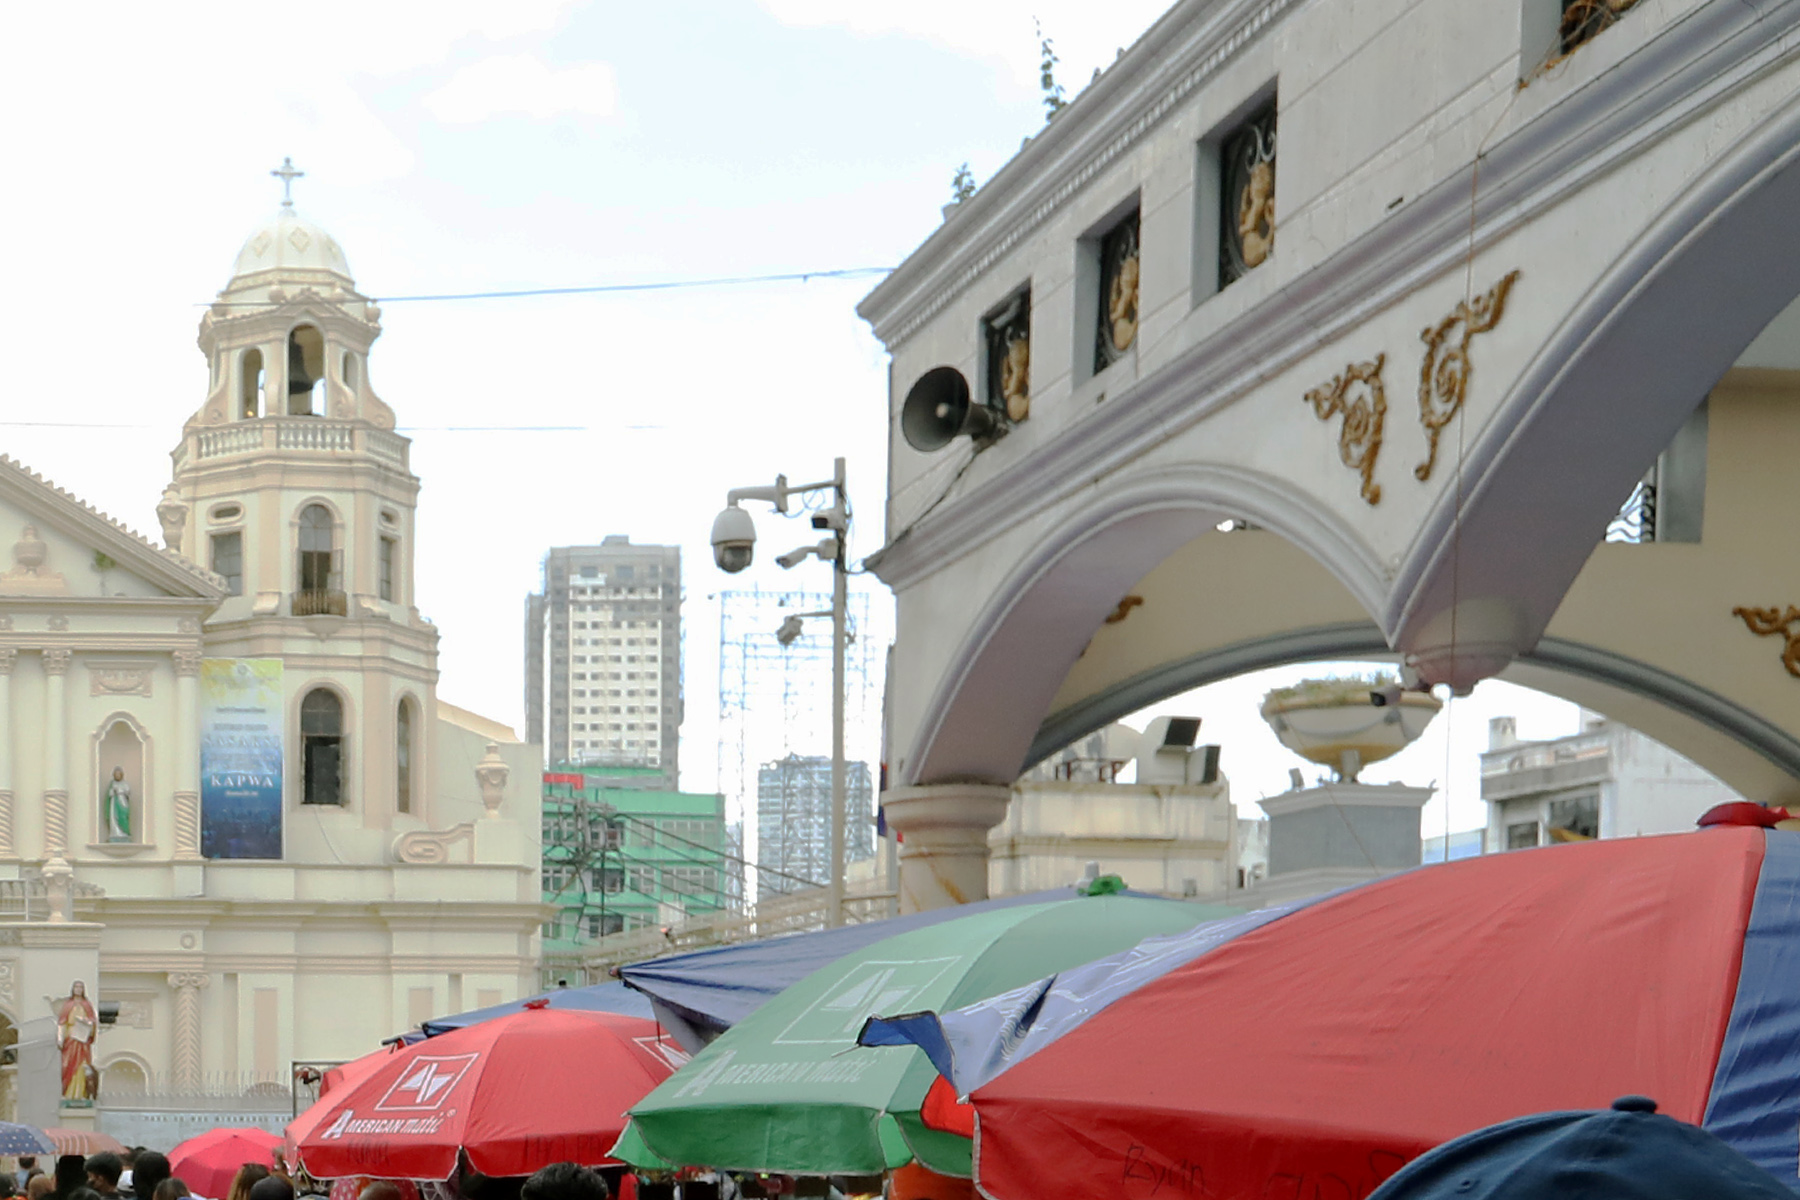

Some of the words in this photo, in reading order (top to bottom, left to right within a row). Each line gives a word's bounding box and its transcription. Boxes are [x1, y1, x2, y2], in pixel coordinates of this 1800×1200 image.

[211, 774, 274, 788] KAPWA
[321, 1109, 403, 1140] AMERICAN
[401, 1110, 446, 1135] matic
